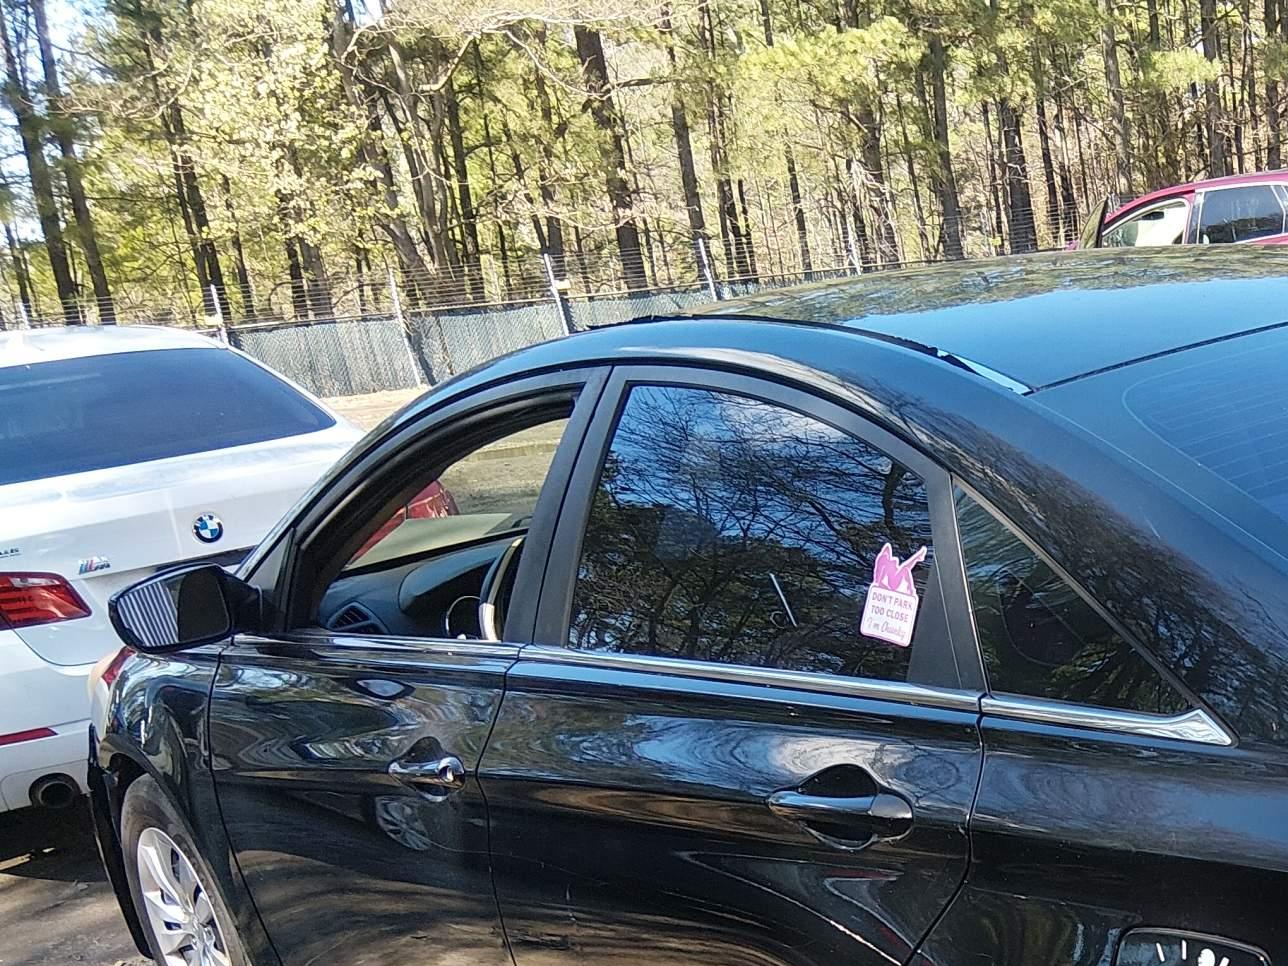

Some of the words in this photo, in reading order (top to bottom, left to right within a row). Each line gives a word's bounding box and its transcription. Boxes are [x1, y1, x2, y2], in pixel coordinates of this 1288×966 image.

[894, 597, 913, 611] PARK
[871, 604, 885, 616] TOO
[886, 608, 909, 623] CLOSE
